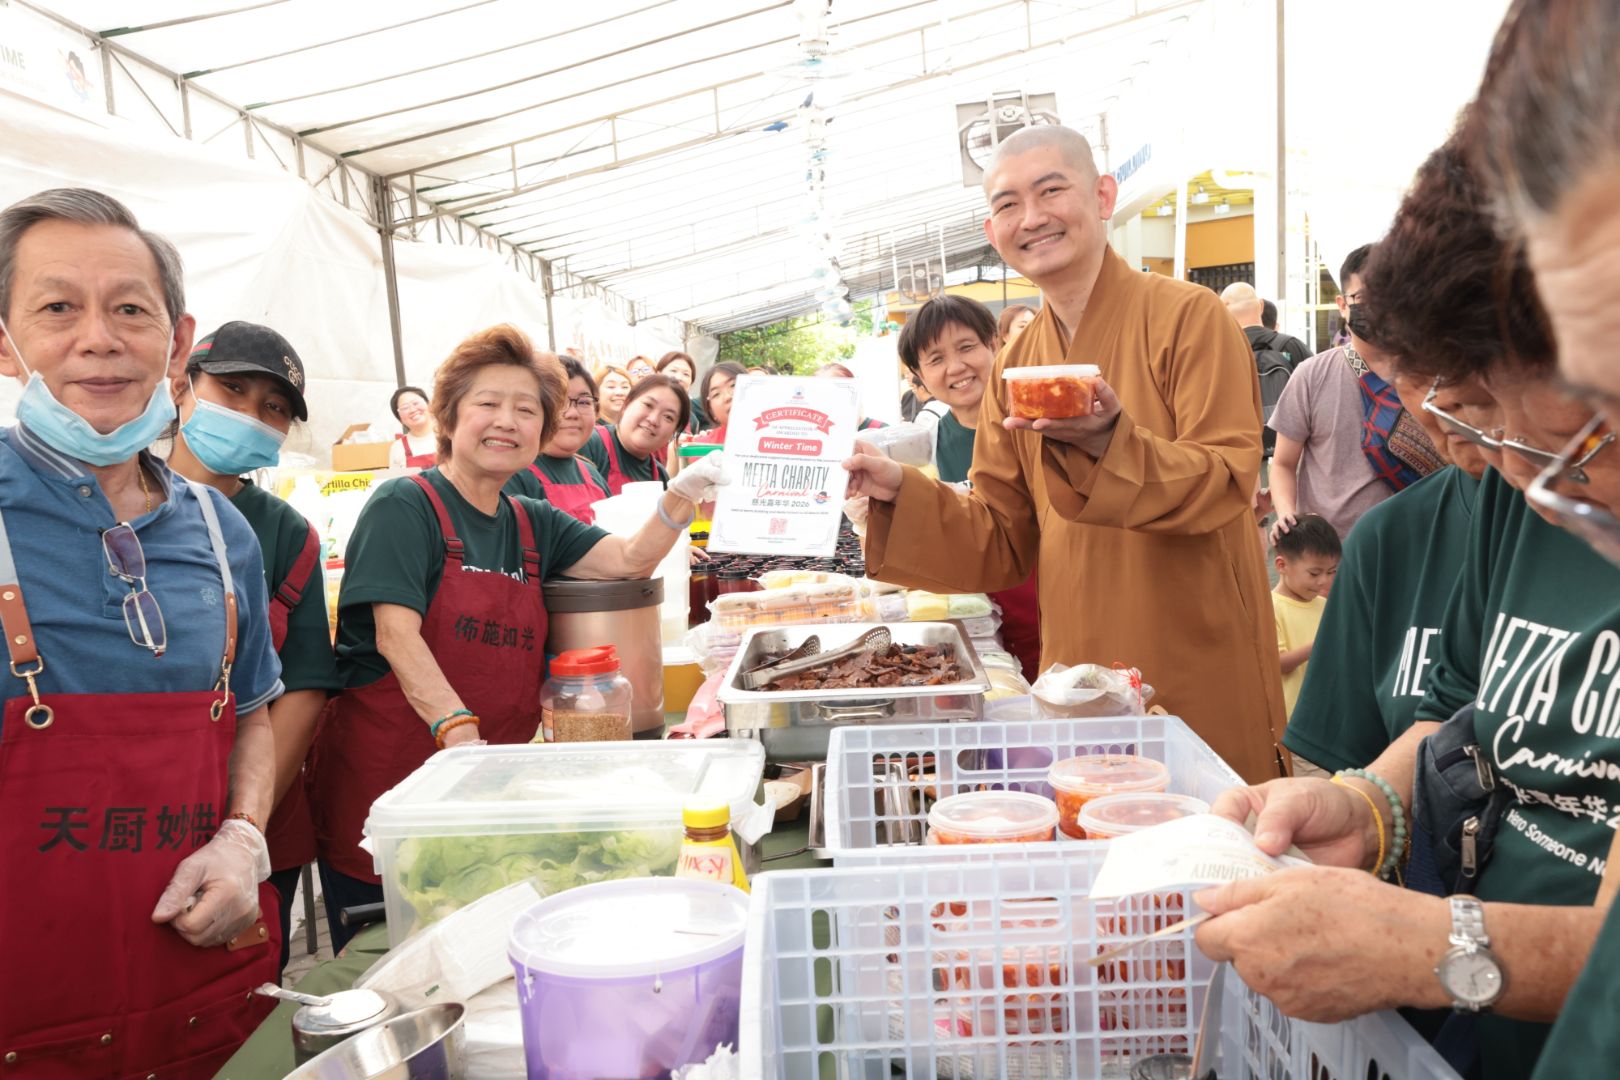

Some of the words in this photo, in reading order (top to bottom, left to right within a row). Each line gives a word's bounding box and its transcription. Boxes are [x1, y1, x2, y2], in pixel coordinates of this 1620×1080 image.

[765, 408, 825, 425] CERTIFICATE
[763, 440, 794, 450] Winter
[796, 442, 818, 452] Time
[352, 478, 371, 488] Chi
[742, 462, 778, 488] METTA
[780, 464, 830, 491] CHARITY
[757, 481, 810, 498] Carnival
[791, 501, 810, 509] 2026
[1392, 626, 1442, 697] ME
[1524, 823, 1588, 867] Someone
[1587, 857, 1607, 877] N
